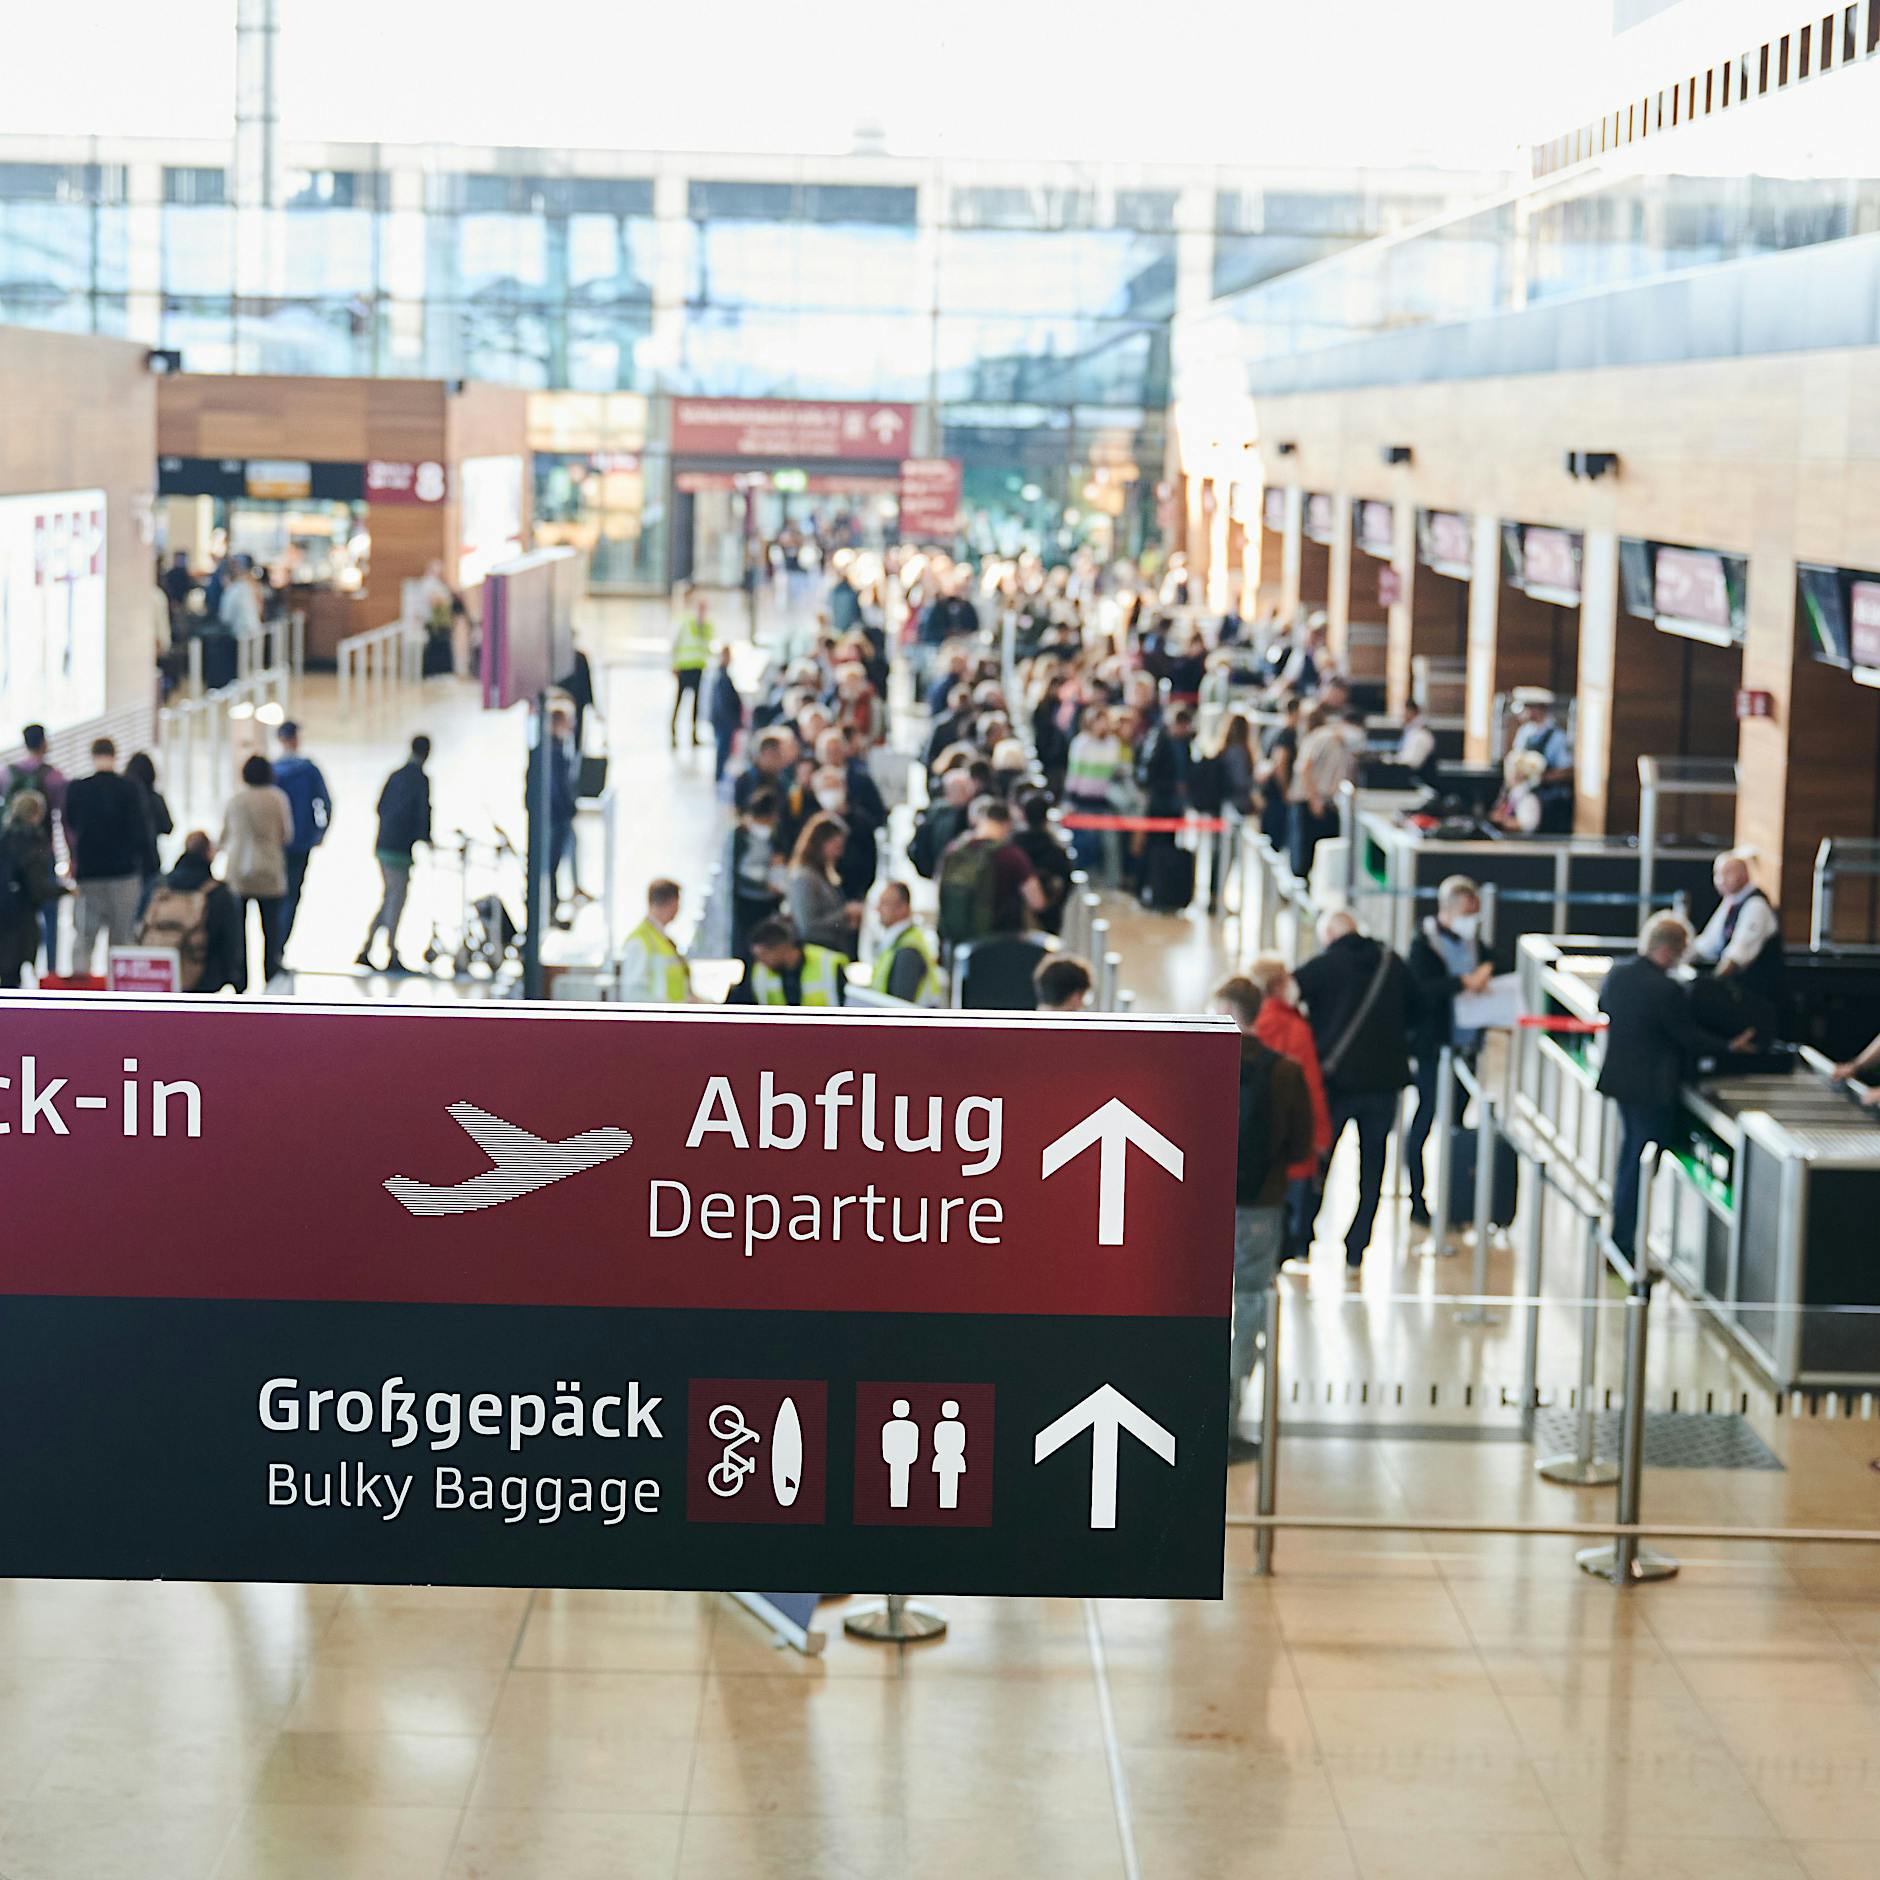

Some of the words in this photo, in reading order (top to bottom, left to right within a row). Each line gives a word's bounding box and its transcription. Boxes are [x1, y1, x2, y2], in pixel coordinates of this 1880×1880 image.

[685, 1070, 1004, 1177] Abflug
[648, 1180, 1004, 1257] Departure
[258, 1376, 664, 1451] Großgepäck
[268, 1461, 413, 1521] Bulky
[435, 1466, 661, 1525] Baggage
